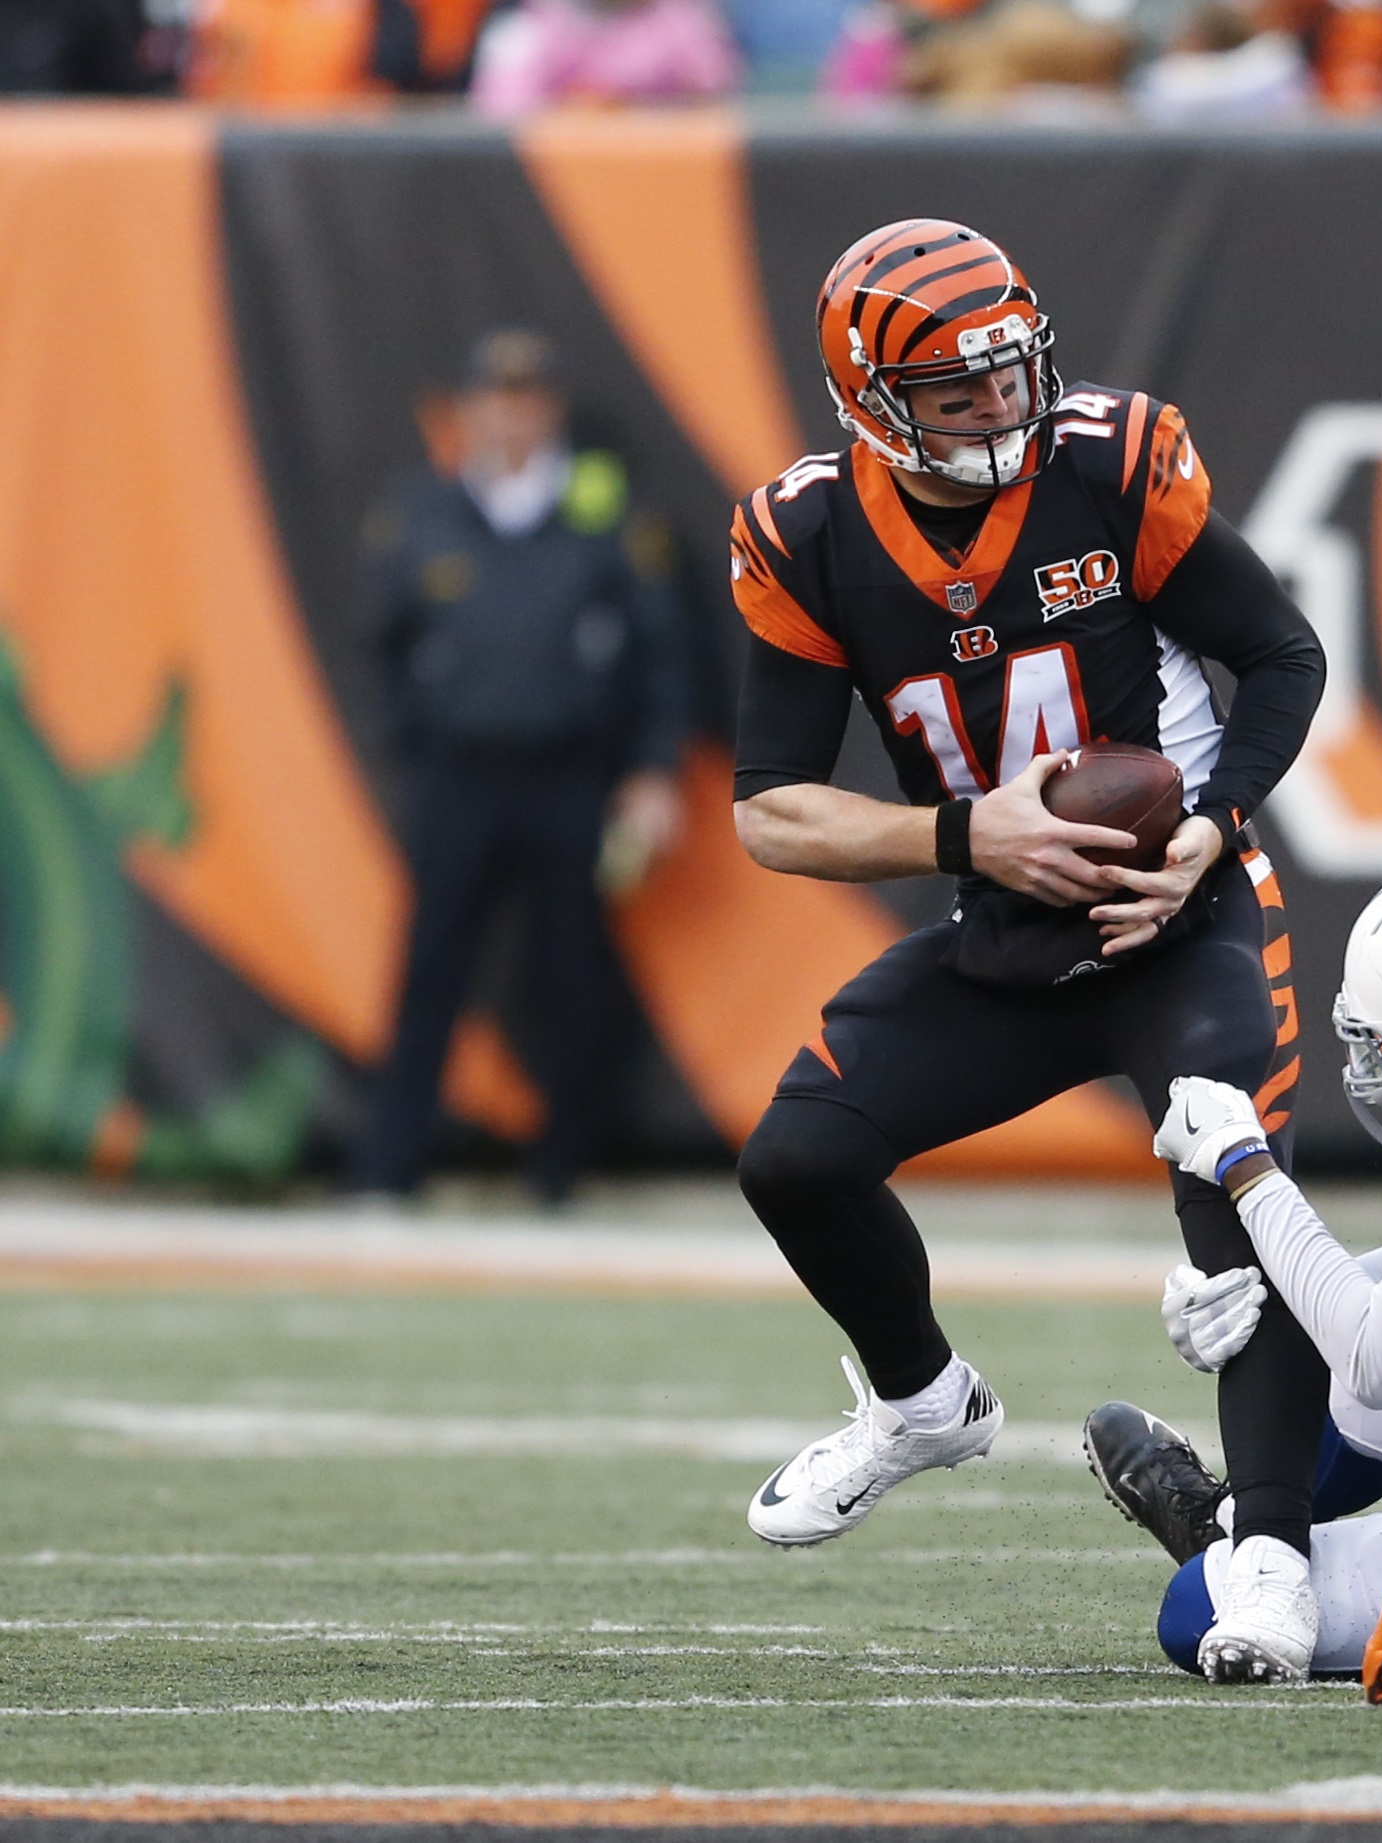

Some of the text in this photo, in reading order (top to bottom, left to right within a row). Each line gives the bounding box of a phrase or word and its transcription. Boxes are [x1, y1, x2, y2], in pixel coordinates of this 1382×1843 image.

[1053, 391, 1122, 446] 14
[774, 451, 840, 503] 14
[1033, 549, 1119, 606] 50
[884, 641, 1100, 801] 14
